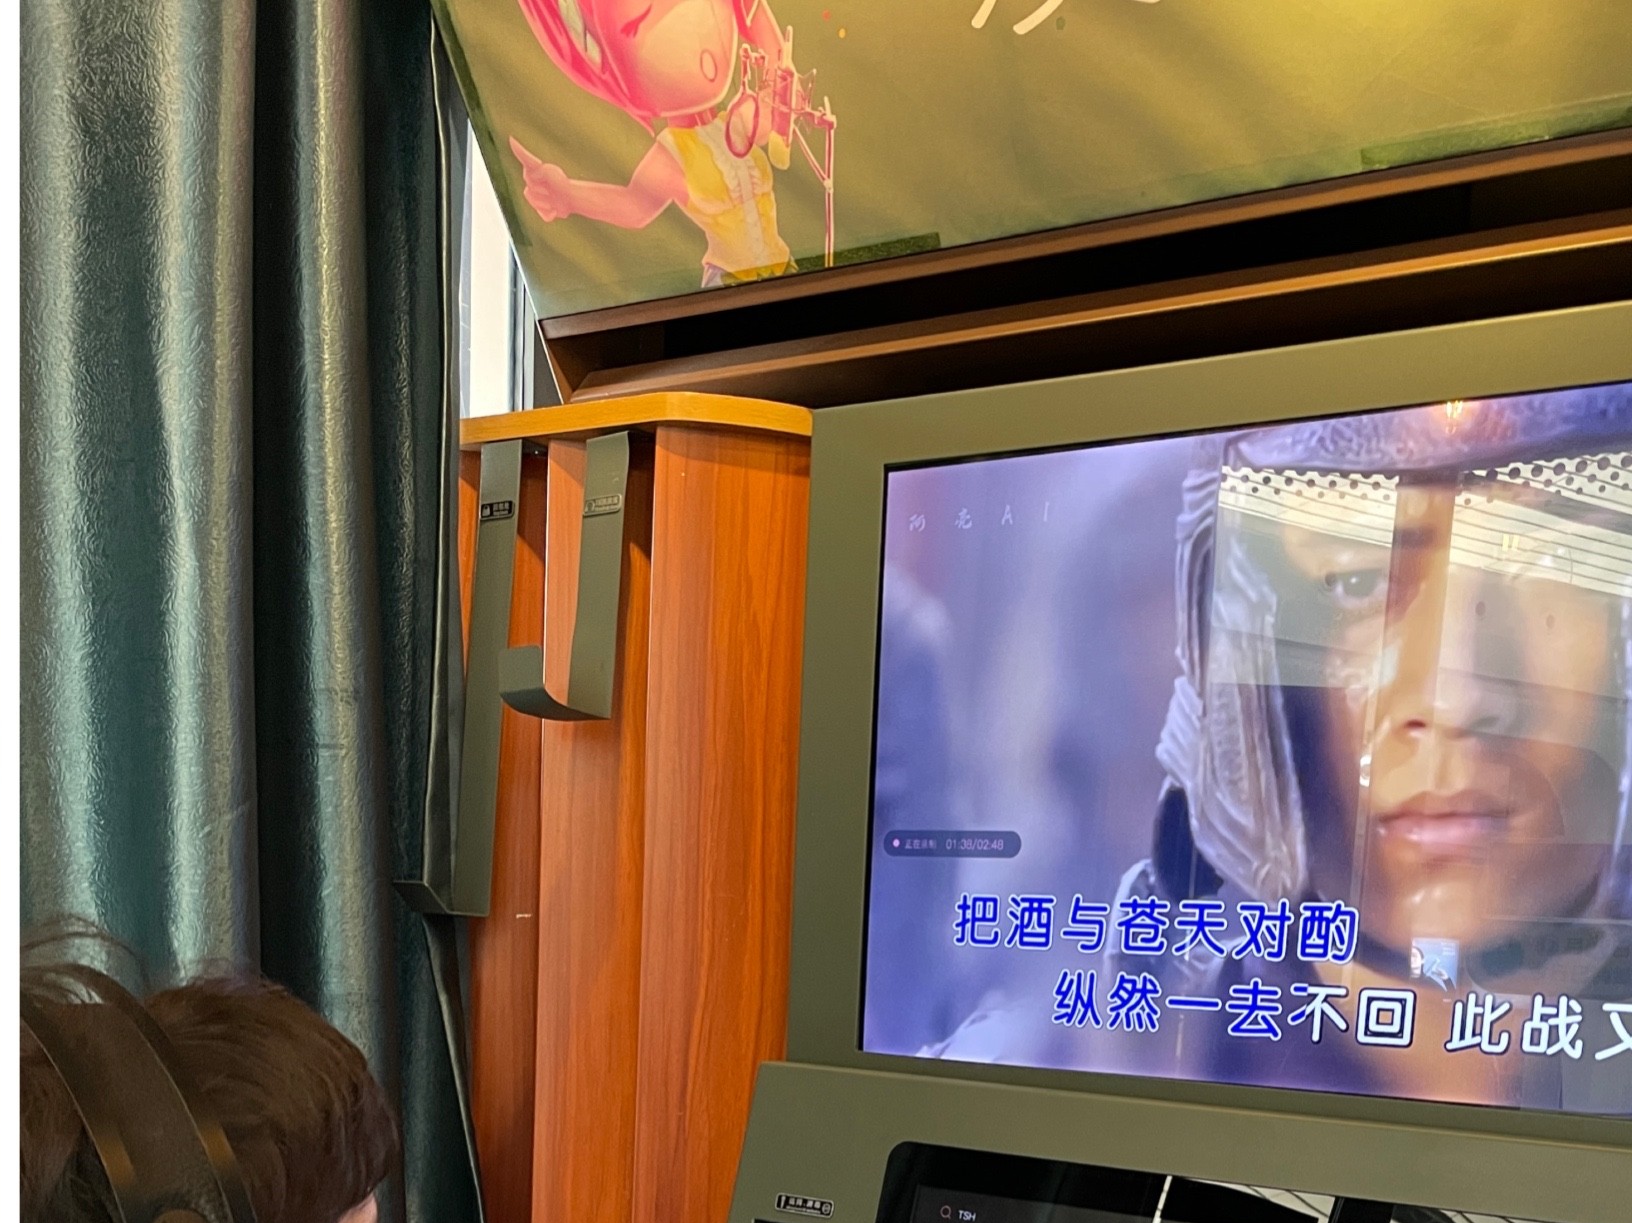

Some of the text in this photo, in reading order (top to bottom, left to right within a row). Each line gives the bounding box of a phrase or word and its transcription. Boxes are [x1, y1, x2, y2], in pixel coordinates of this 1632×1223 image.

[953, 893, 1359, 964] 把酒与苍天对酌
[1052, 970, 1415, 1048] 纵然一去不回
[958, 1209, 976, 1222] TSH
